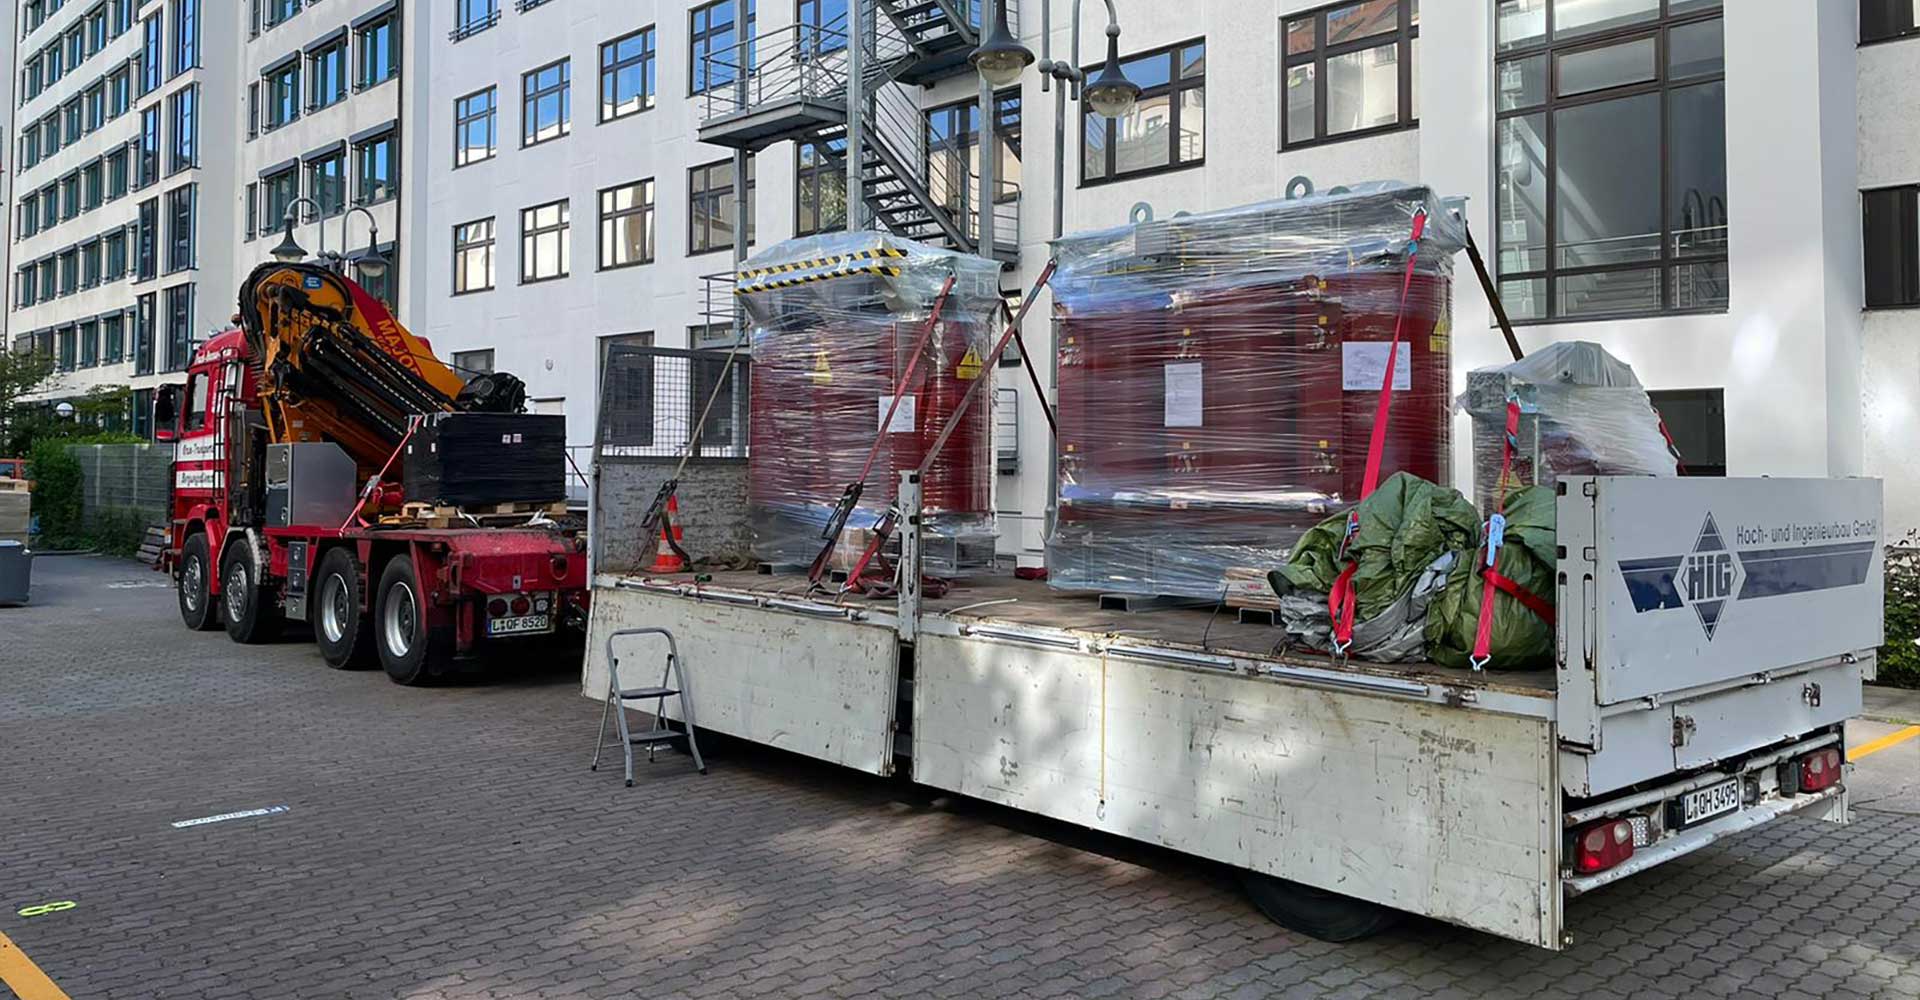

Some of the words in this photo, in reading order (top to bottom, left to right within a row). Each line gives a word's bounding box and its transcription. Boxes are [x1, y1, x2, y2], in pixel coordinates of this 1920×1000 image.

[1736, 525, 1768, 545] Hoch-
[1772, 524, 1790, 543] und
[1792, 522, 1850, 545] Ingenieurbau
[1852, 520, 1877, 538] GmbH
